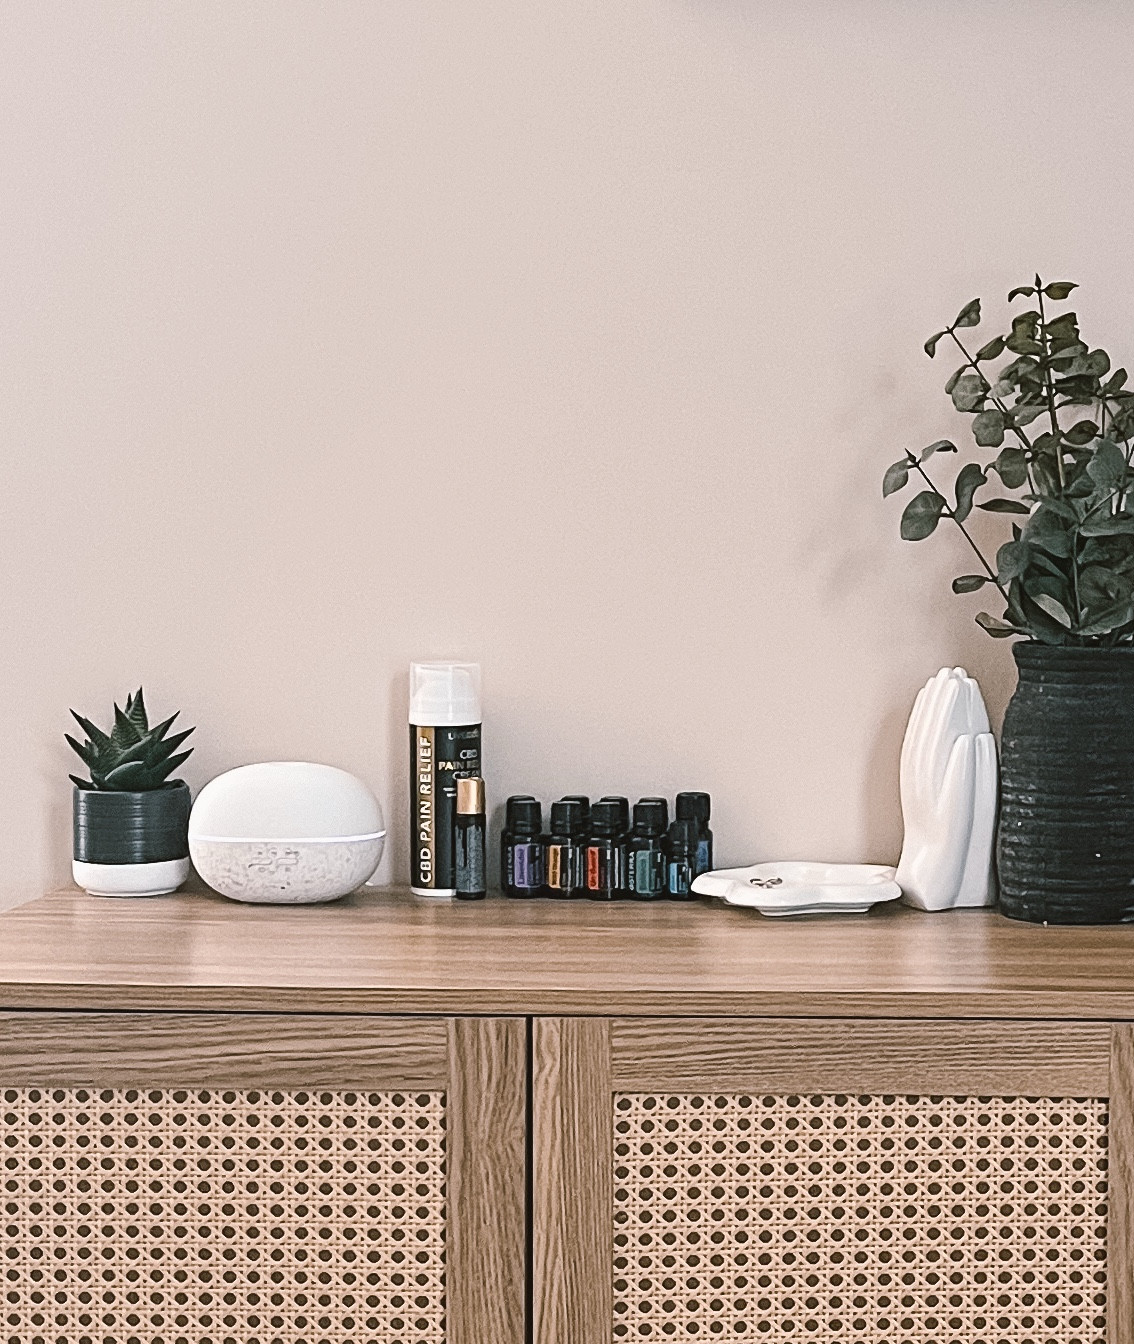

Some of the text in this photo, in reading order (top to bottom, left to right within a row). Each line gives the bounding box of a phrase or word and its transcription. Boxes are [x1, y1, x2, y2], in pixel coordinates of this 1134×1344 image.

[419, 736, 432, 883] CBD PAIN RELIEF
